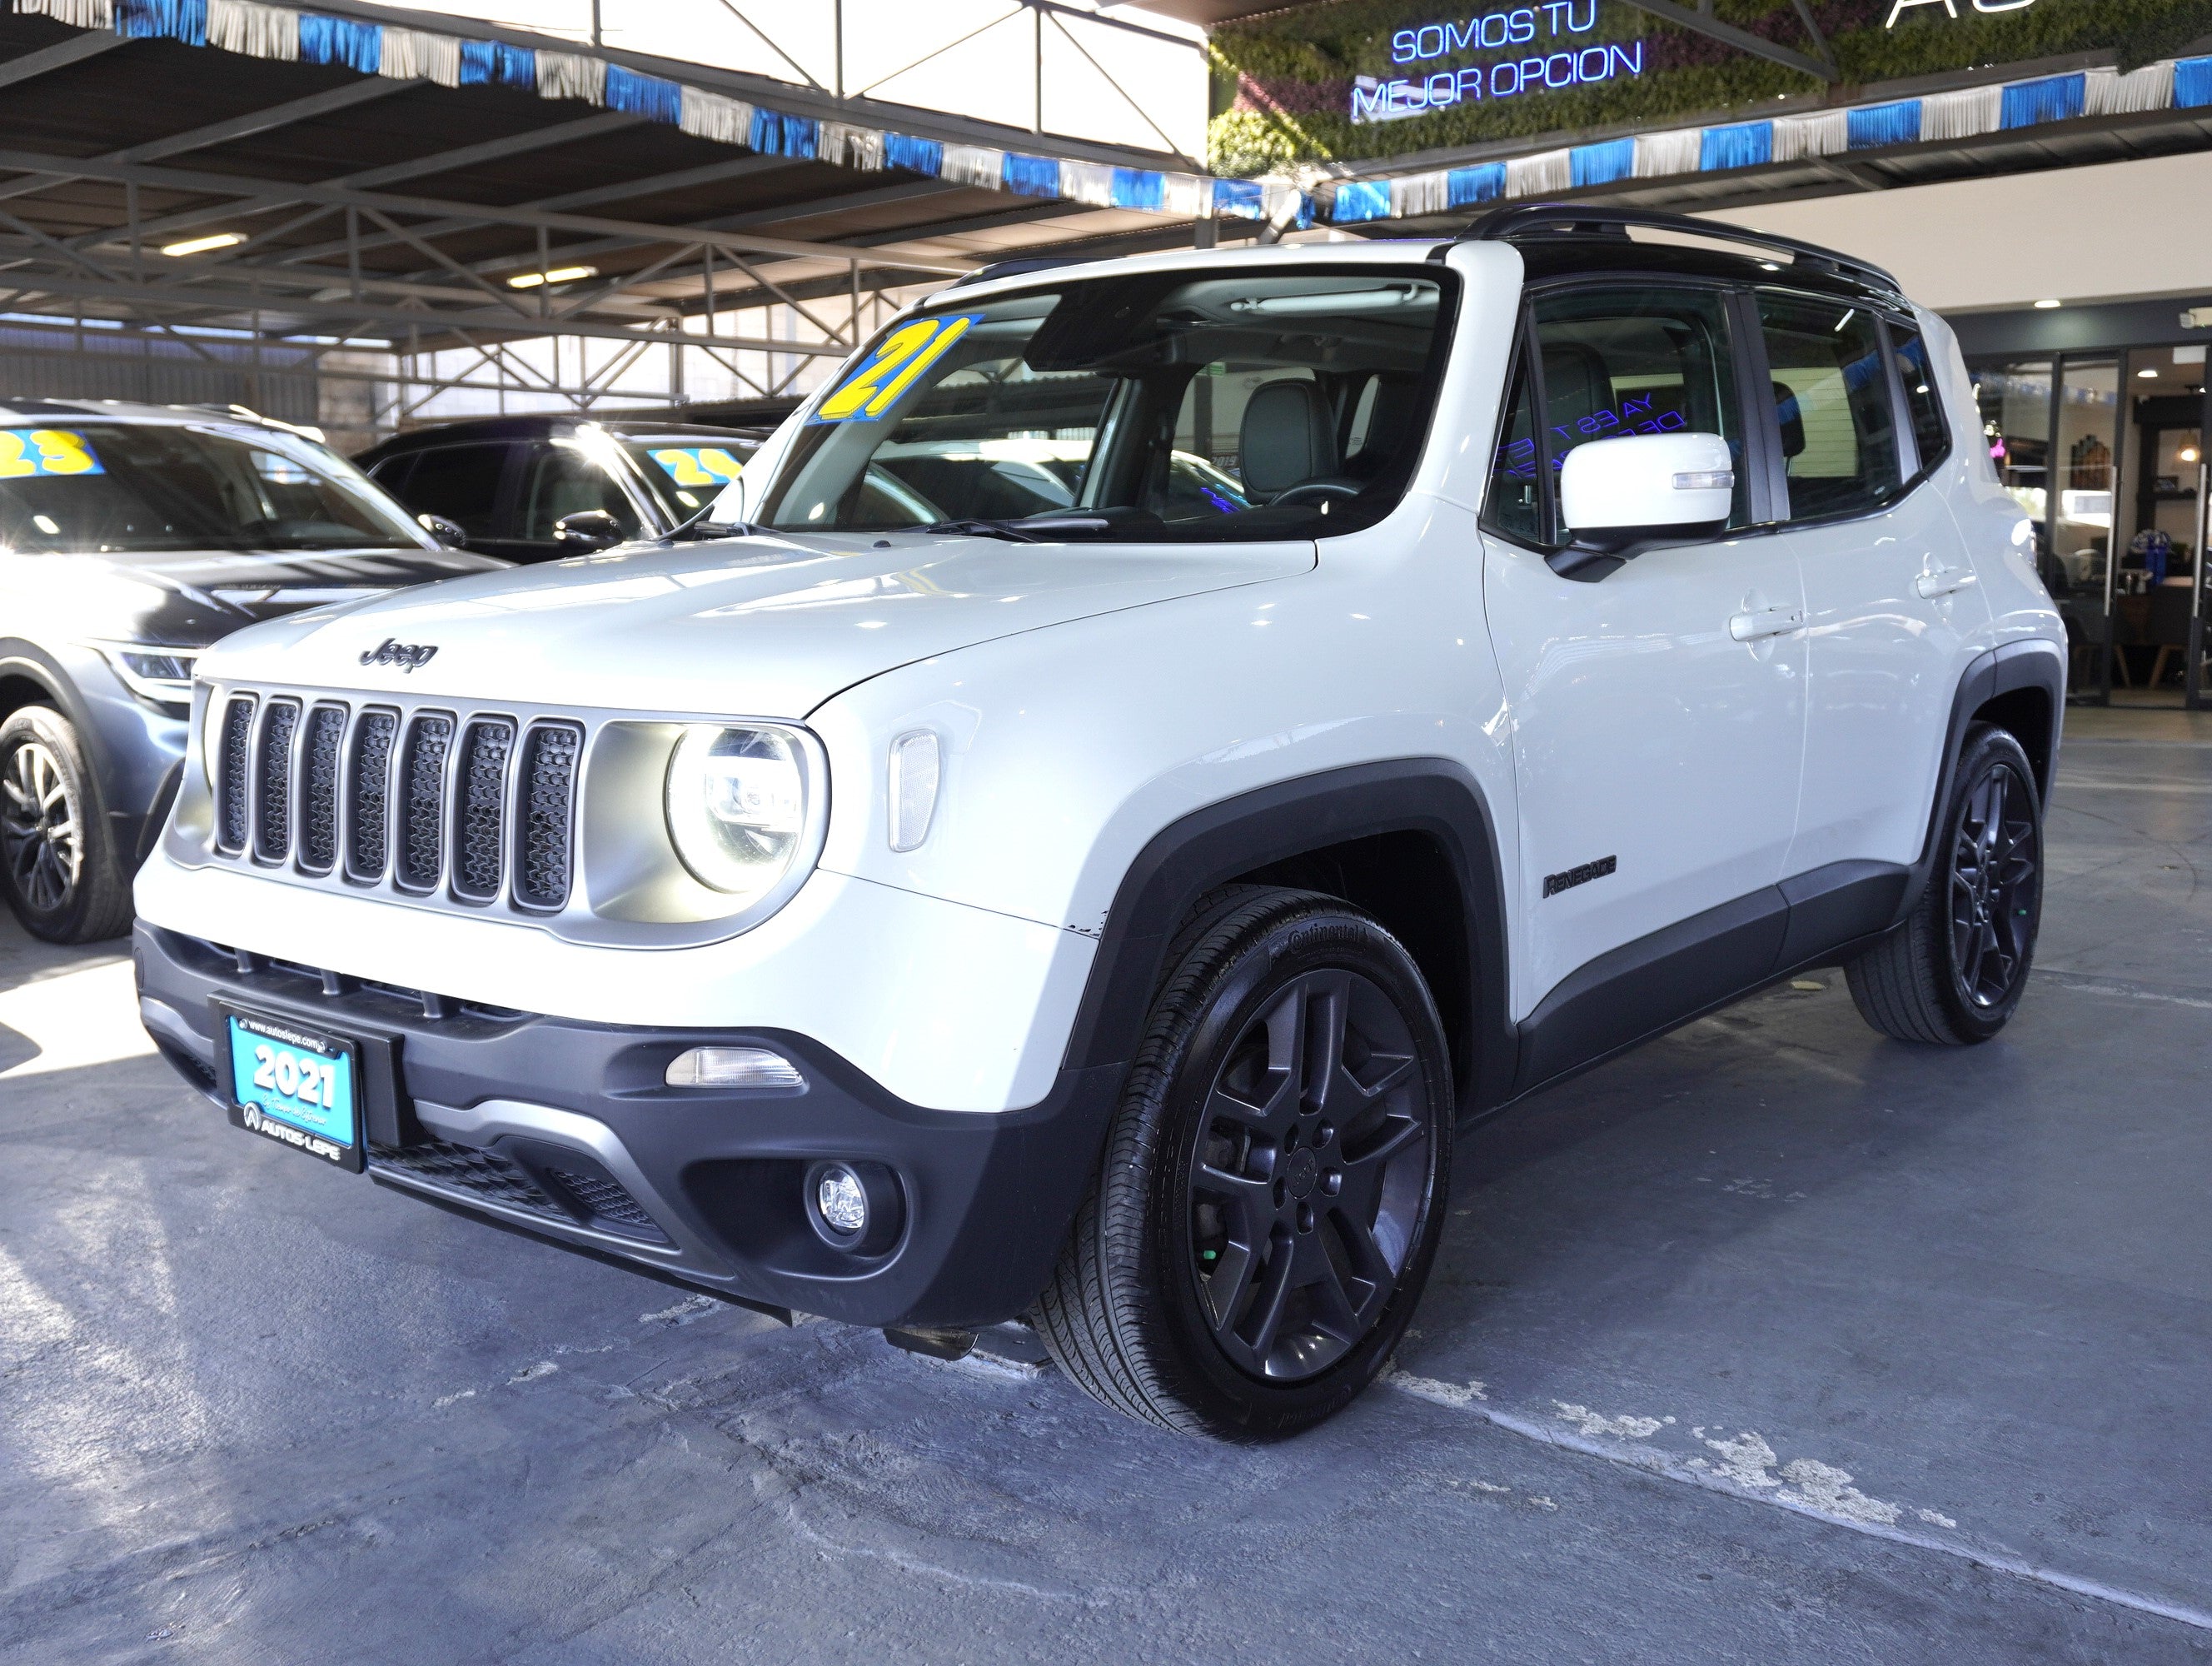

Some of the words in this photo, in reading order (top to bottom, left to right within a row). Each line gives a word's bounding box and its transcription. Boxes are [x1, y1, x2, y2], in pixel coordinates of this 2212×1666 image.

[1392, 9, 1534, 63] SOMOS
[1542, 0, 1595, 36] TU
[1353, 68, 1482, 118] MEJOR
[1490, 41, 1642, 97] OPCION
[819, 317, 969, 420] 21
[359, 637, 439, 674] Jeep
[1542, 855, 1617, 899] RENEGADE
[1288, 923, 1359, 954] Continental
[248, 1020, 320, 1049] www.autoslepe.com
[253, 1045, 336, 1110] 2021
